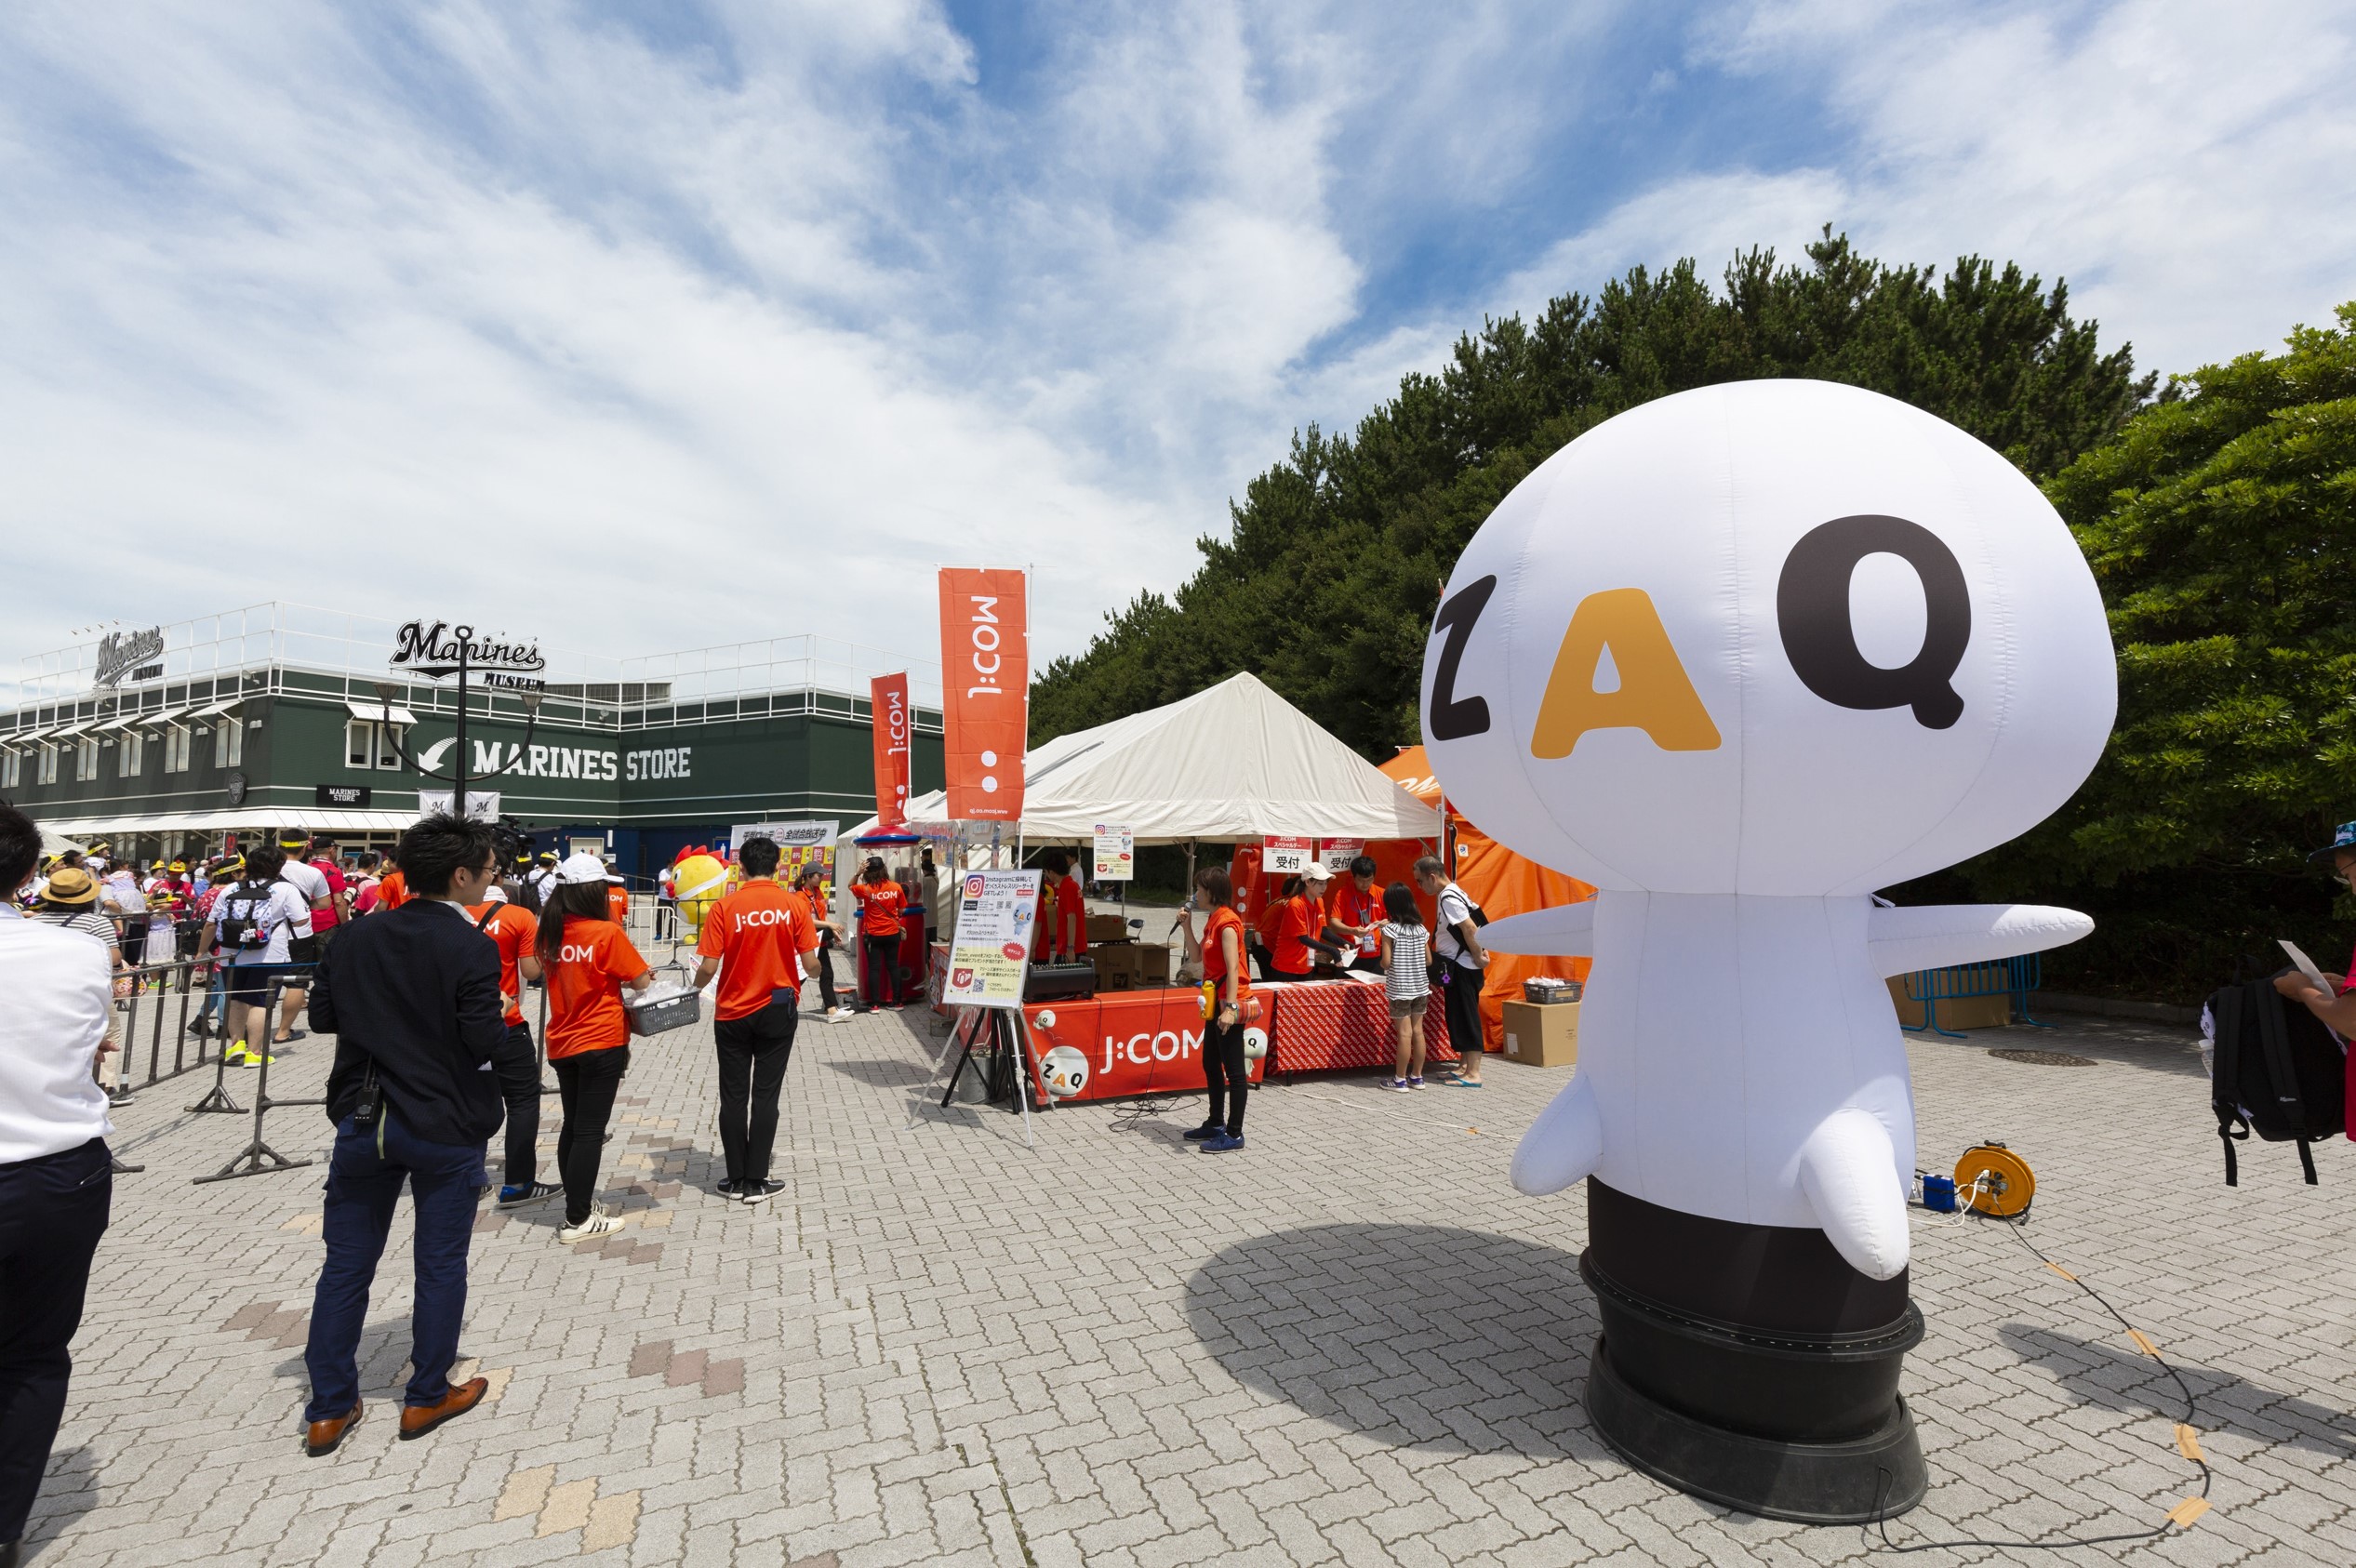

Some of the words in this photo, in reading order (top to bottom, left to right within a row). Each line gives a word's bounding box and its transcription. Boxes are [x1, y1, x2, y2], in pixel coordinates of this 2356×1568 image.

[388, 618, 546, 668] Marines
[484, 672, 546, 692] MUSEUM
[473, 739, 618, 780] MARINES
[626, 747, 691, 781] STORE
[328, 788, 361, 796] MARINES
[1275, 856, 1300, 870] 受付
[1330, 857, 1351, 870] 受付
[735, 908, 791, 933] J:COM
[1098, 1029, 1205, 1074] J:COM
